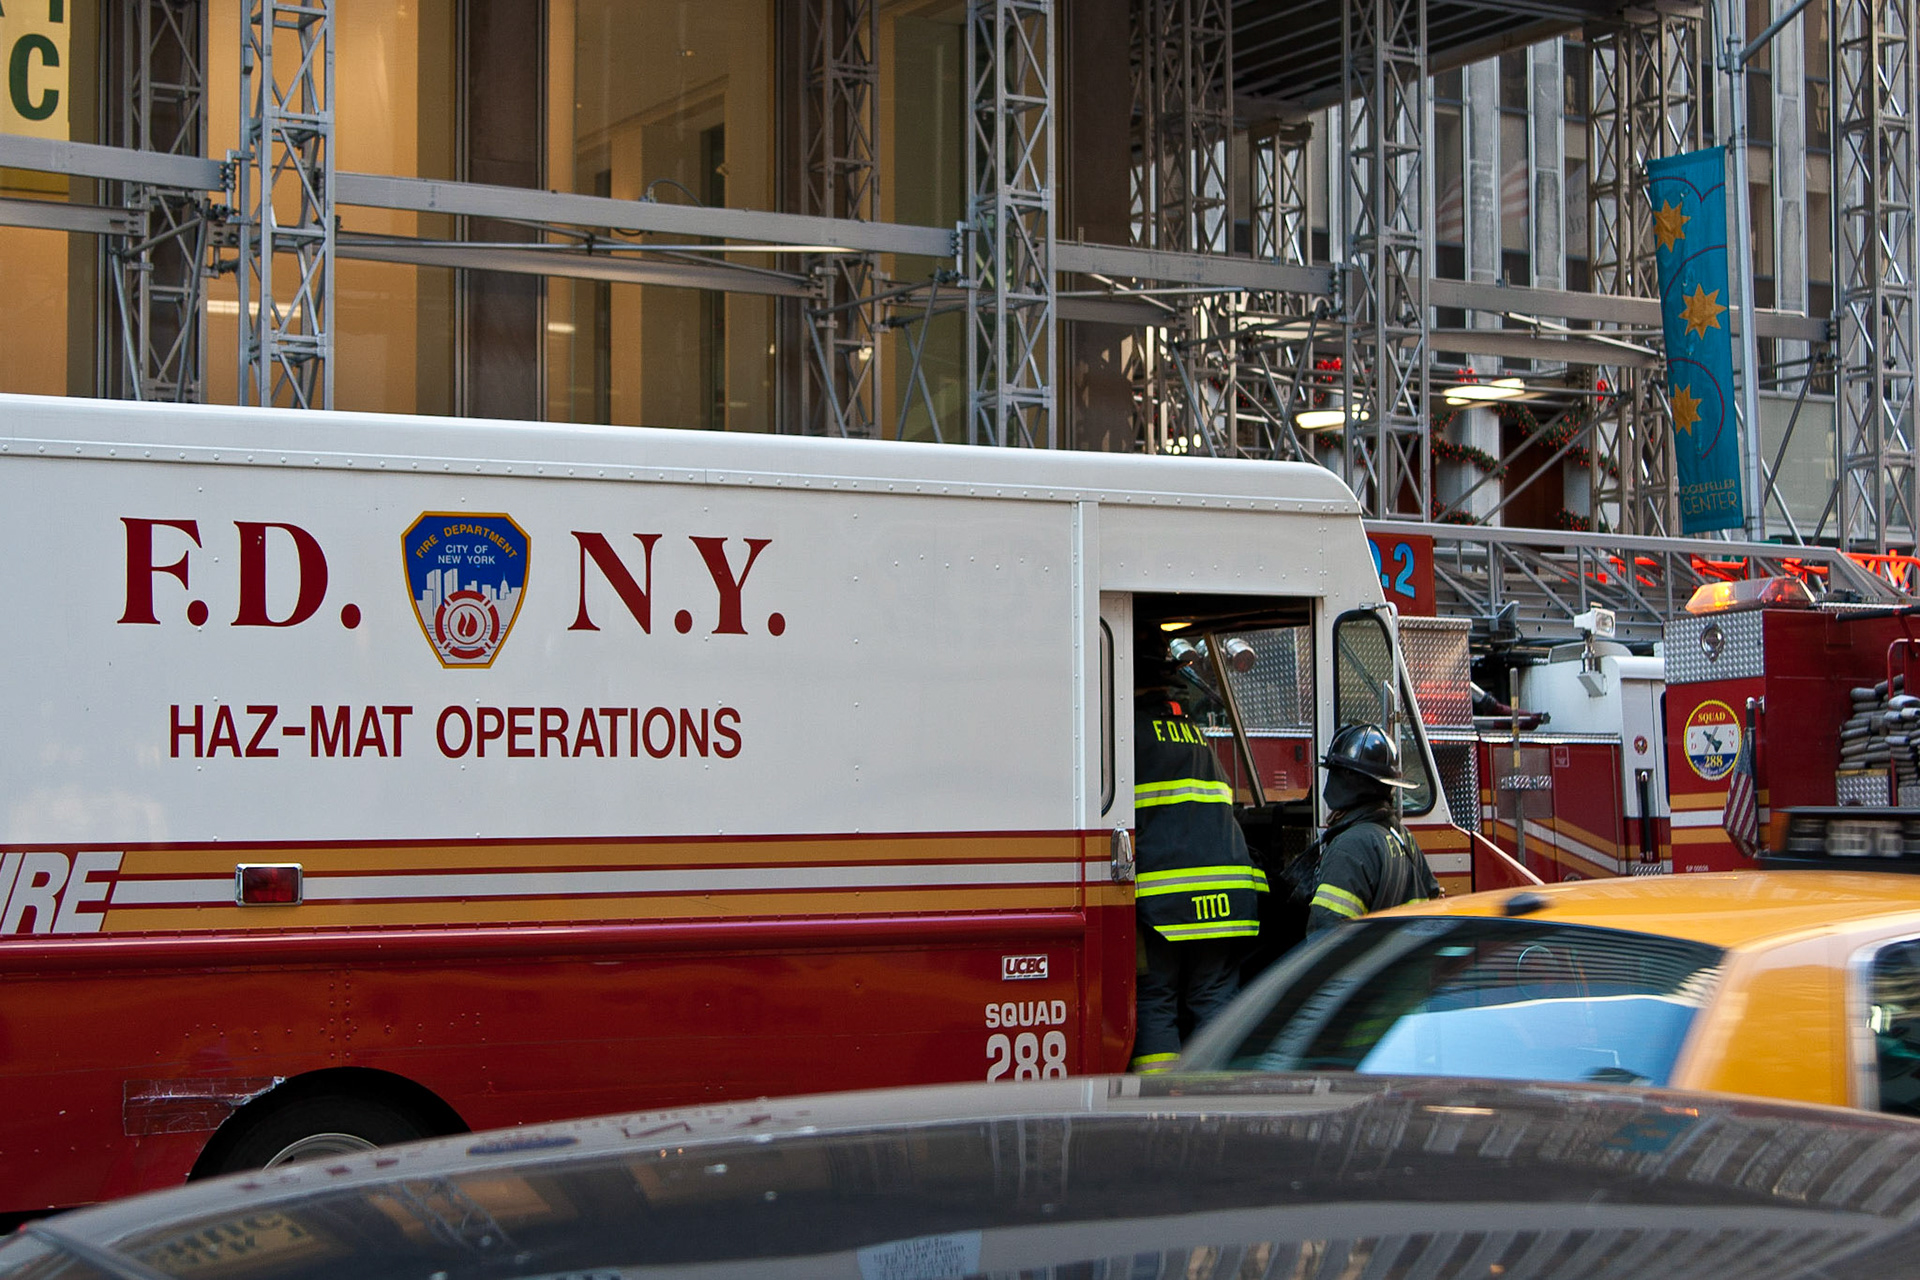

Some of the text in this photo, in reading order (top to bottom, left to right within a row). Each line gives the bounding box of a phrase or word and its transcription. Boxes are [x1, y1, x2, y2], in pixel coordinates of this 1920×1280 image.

[9, 33, 60, 121] C
[1682, 491, 1738, 515] CENTER
[415, 524, 517, 559] FIRE DEPARTMENT
[445, 544, 489, 554] CITY OF
[438, 554, 496, 566] NEW YORK
[117, 517, 786, 637] F.D. N.Y.
[170, 704, 742, 760] HAZ-MAT OPERATIONS
[1698, 712, 1725, 724] SQUAD
[1704, 755, 1723, 767] 288
[0, 852, 124, 935] IRE
[1191, 892, 1231, 920] TITO
[984, 1000, 1068, 1029] SQUAD
[985, 1030, 1068, 1084] 288
